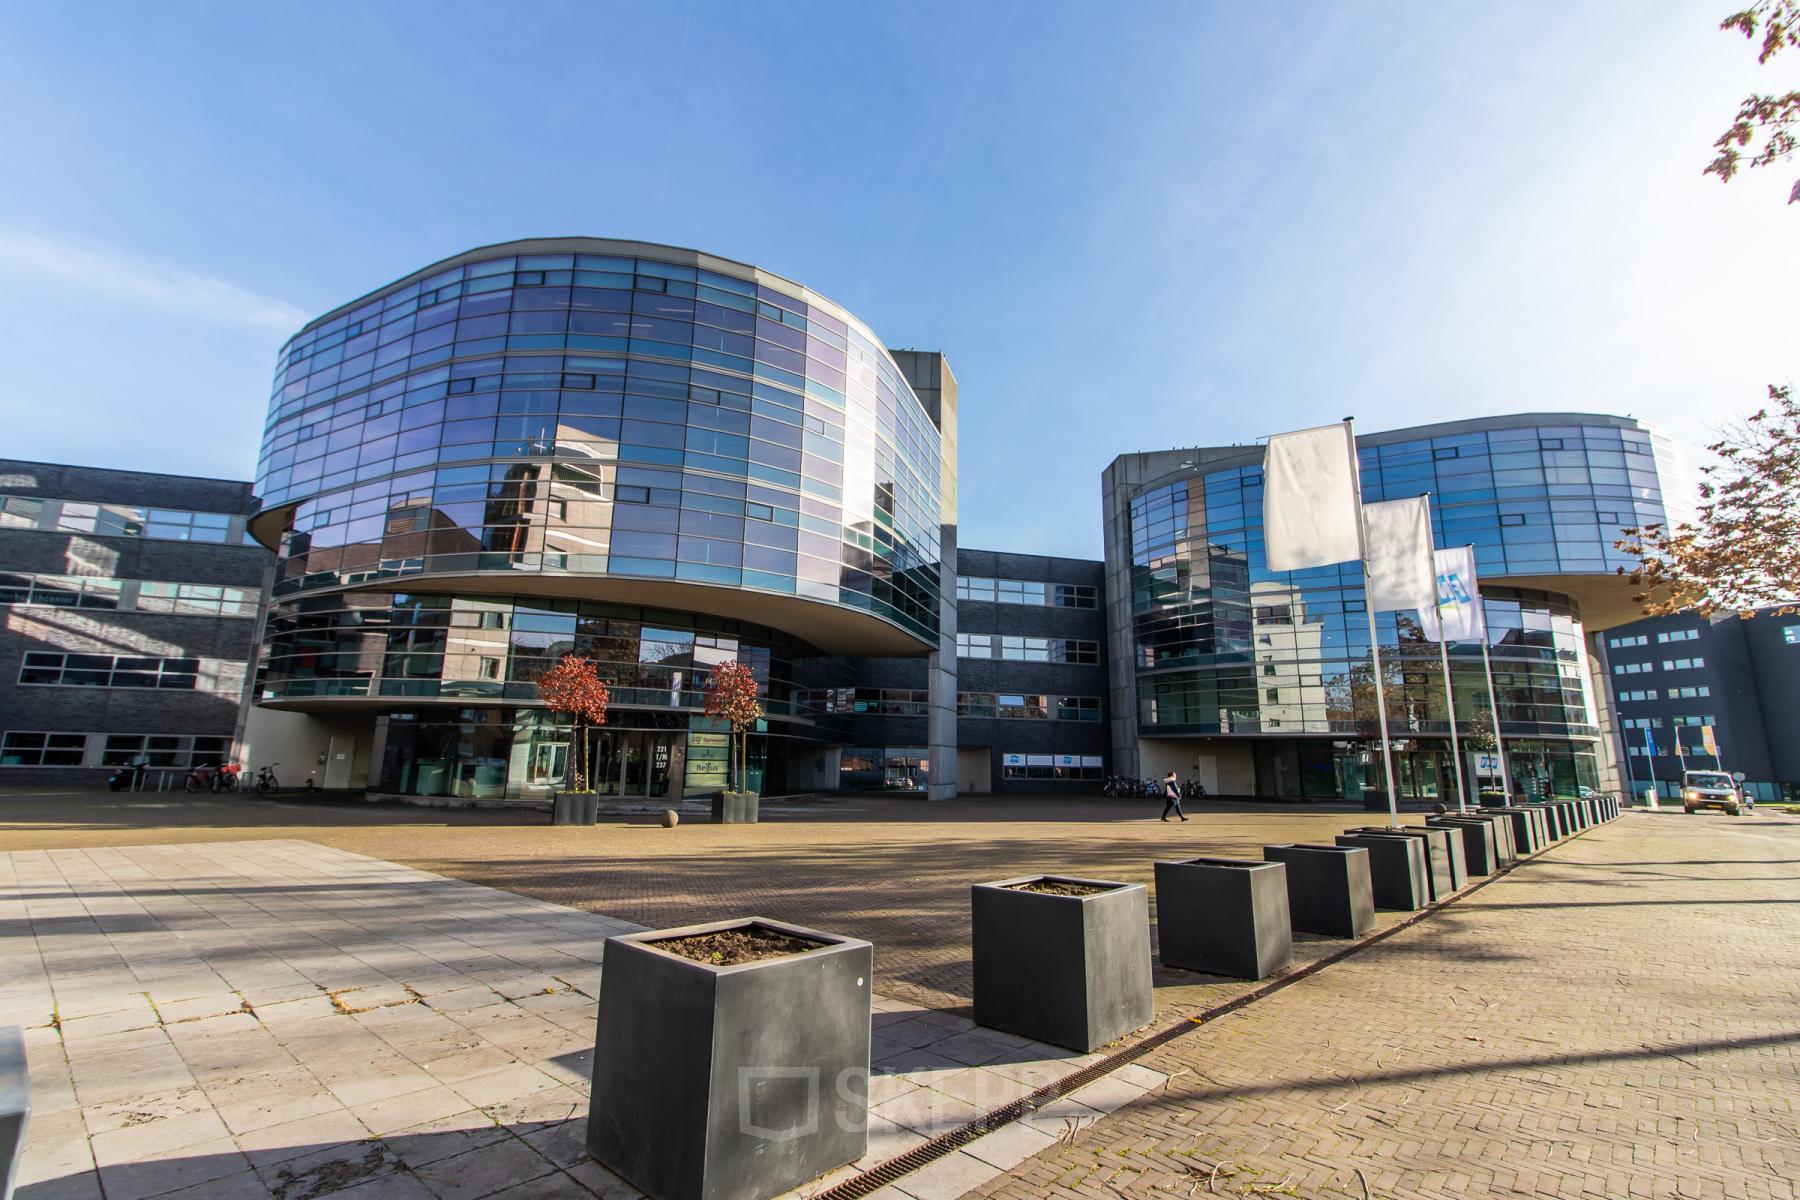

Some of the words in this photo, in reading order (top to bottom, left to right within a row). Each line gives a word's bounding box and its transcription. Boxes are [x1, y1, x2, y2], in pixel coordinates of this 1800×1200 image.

[655, 753, 668, 761] T/M
[655, 761, 667, 769] 237
[696, 762, 719, 773] Regus
